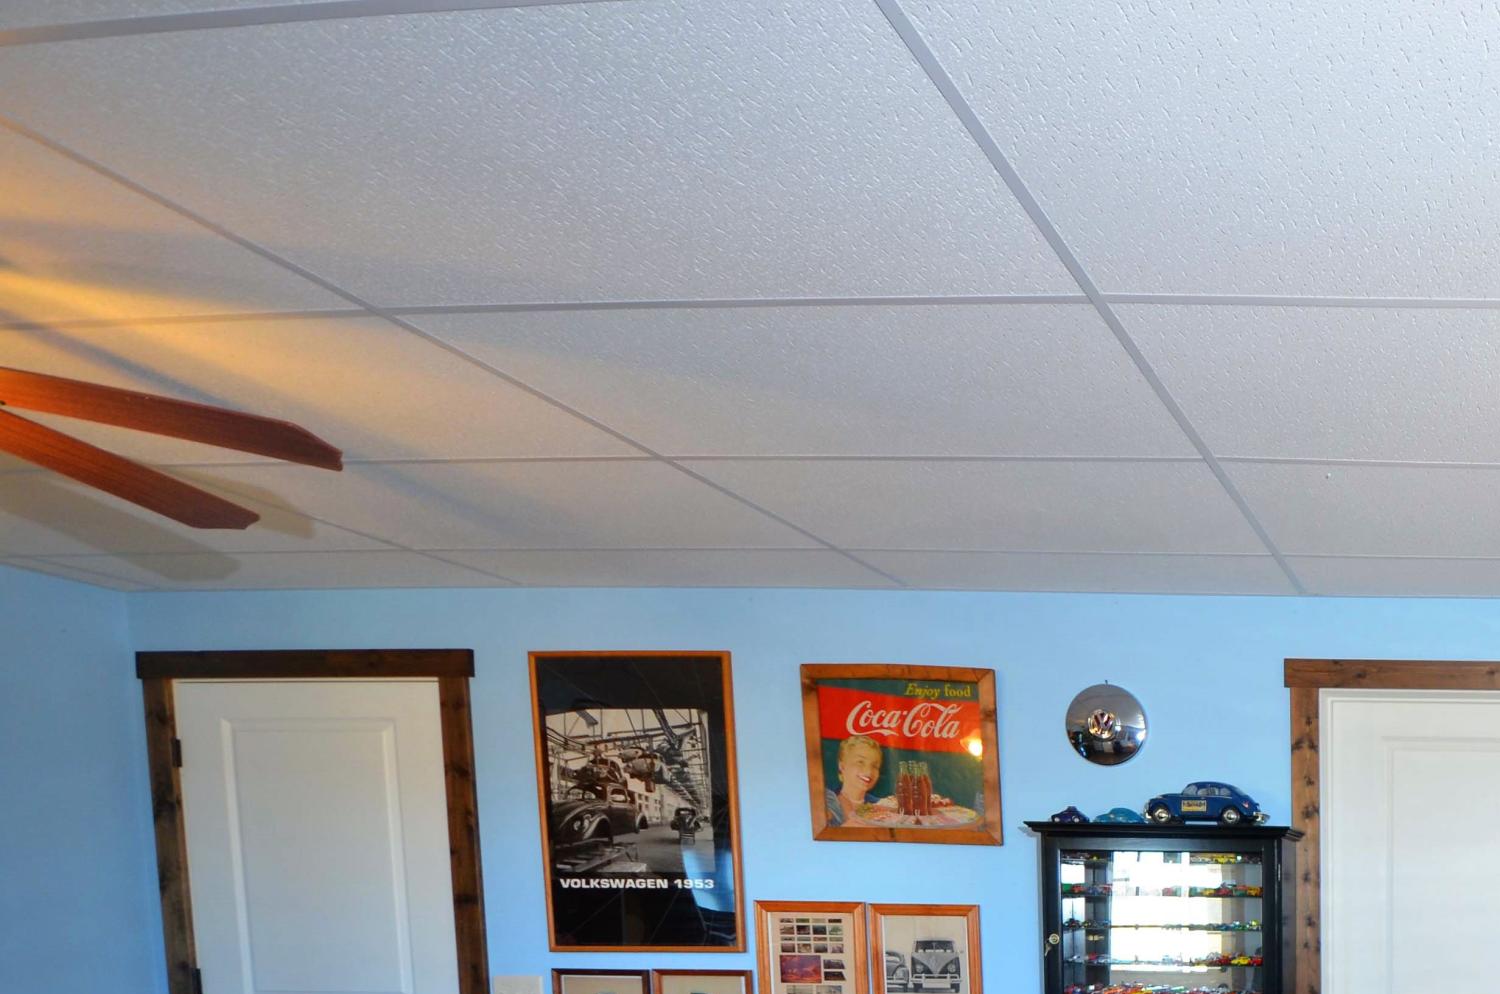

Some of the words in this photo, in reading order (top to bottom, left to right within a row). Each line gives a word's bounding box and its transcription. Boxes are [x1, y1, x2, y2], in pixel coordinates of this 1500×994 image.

[904, 682, 941, 700] Enjoy
[944, 683, 972, 698] food
[846, 700, 963, 739] Coca-Cola
[560, 878, 669, 889] VOLKSWAGEN
[674, 878, 715, 889] 1953
